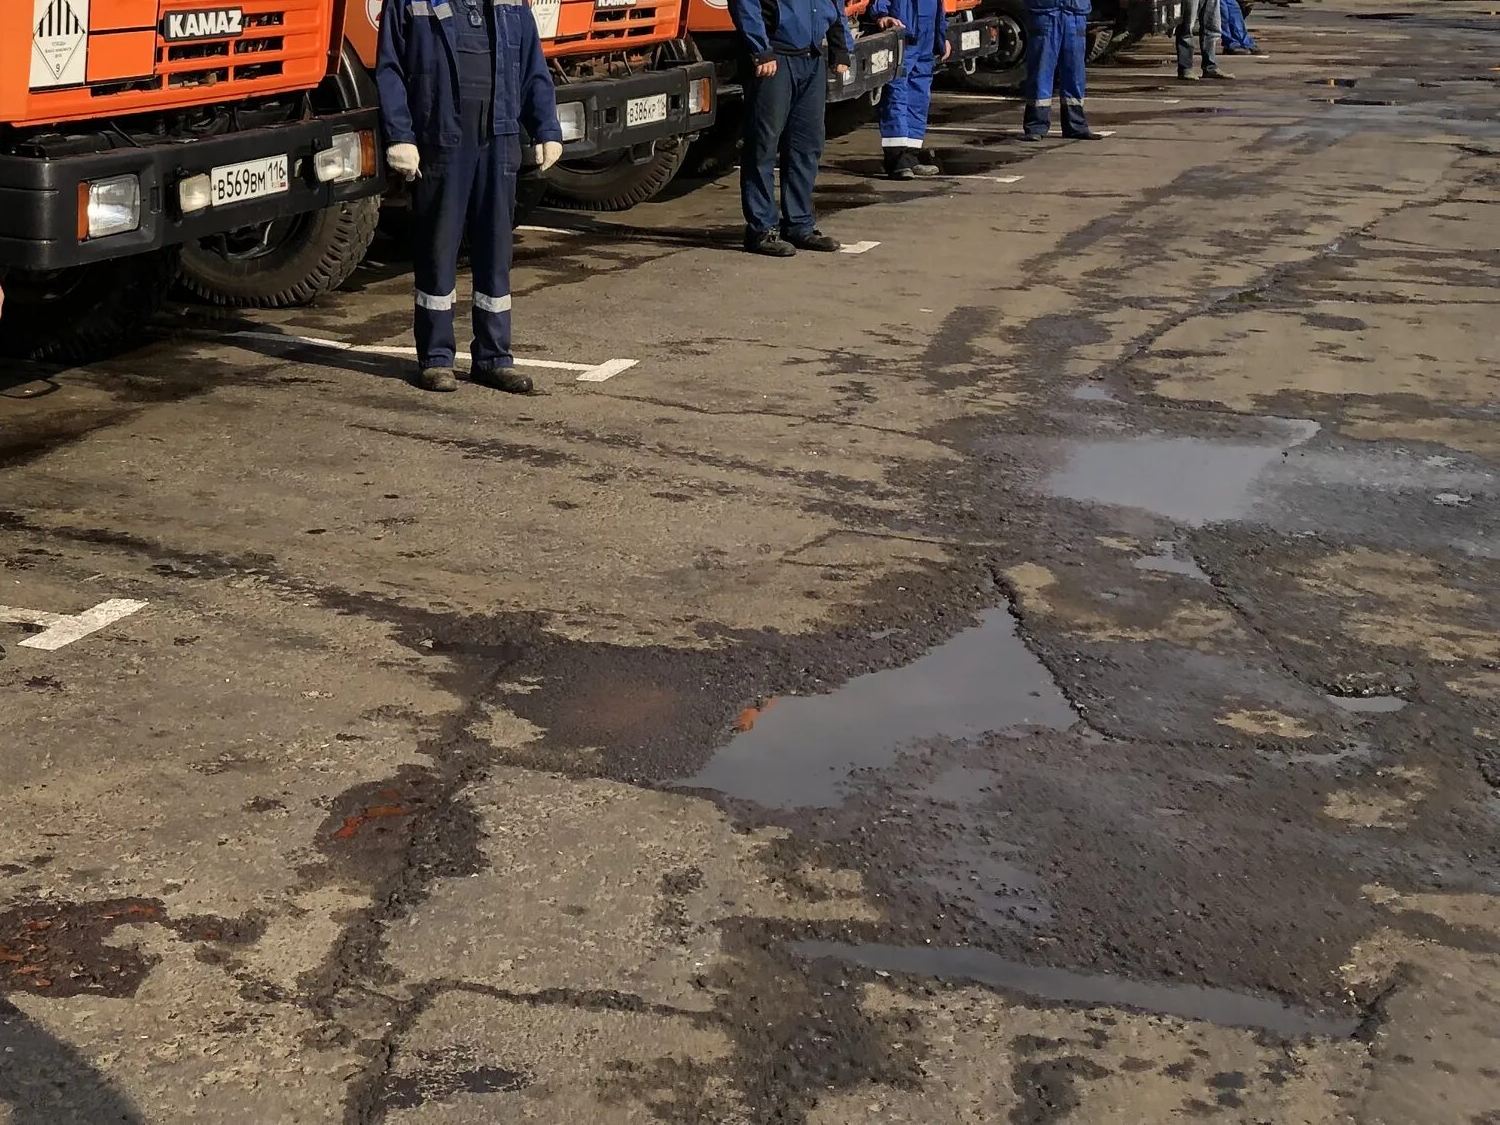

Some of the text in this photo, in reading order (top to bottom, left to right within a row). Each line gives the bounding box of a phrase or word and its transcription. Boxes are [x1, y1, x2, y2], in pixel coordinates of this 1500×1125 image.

[169, 10, 243, 38] KAMAZ
[218, 160, 286, 200] В569ВМ 116
